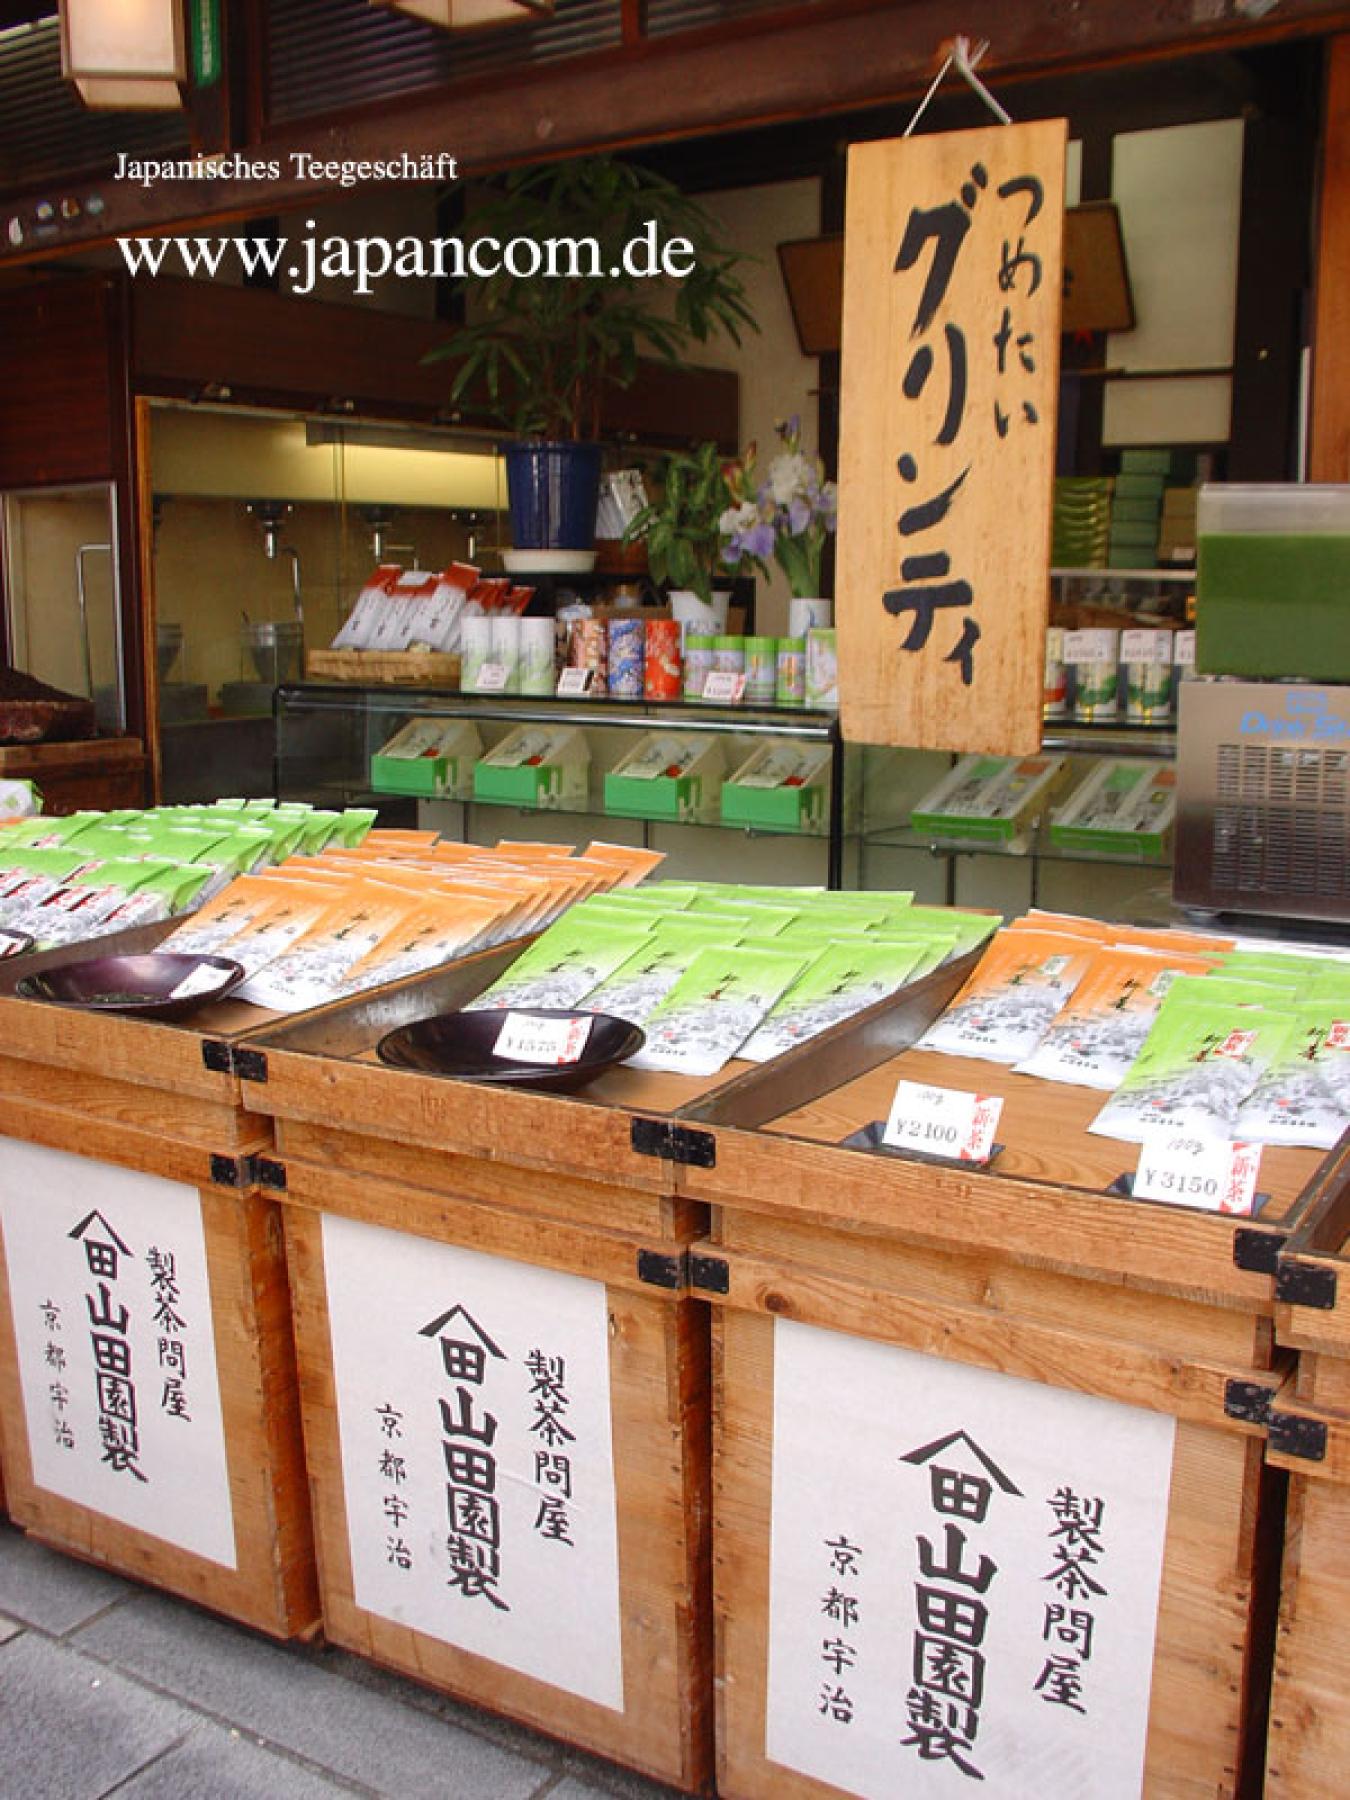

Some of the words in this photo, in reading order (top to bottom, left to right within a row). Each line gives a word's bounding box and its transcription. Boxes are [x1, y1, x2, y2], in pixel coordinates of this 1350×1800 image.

[993, 175, 1045, 440] つめたい
[896, 1116, 958, 1144] ¥2100
[1144, 1167, 1219, 1198] ¥3150
[40, 1299, 75, 1450] 京都宇治
[145, 1246, 191, 1424] 製茶問屋
[375, 1403, 413, 1571] 京都宇治
[524, 1348, 578, 1548] 製茶問屋
[820, 1535, 864, 1725] 京都宇治
[1033, 1486, 1109, 1716] 製茶問屋
